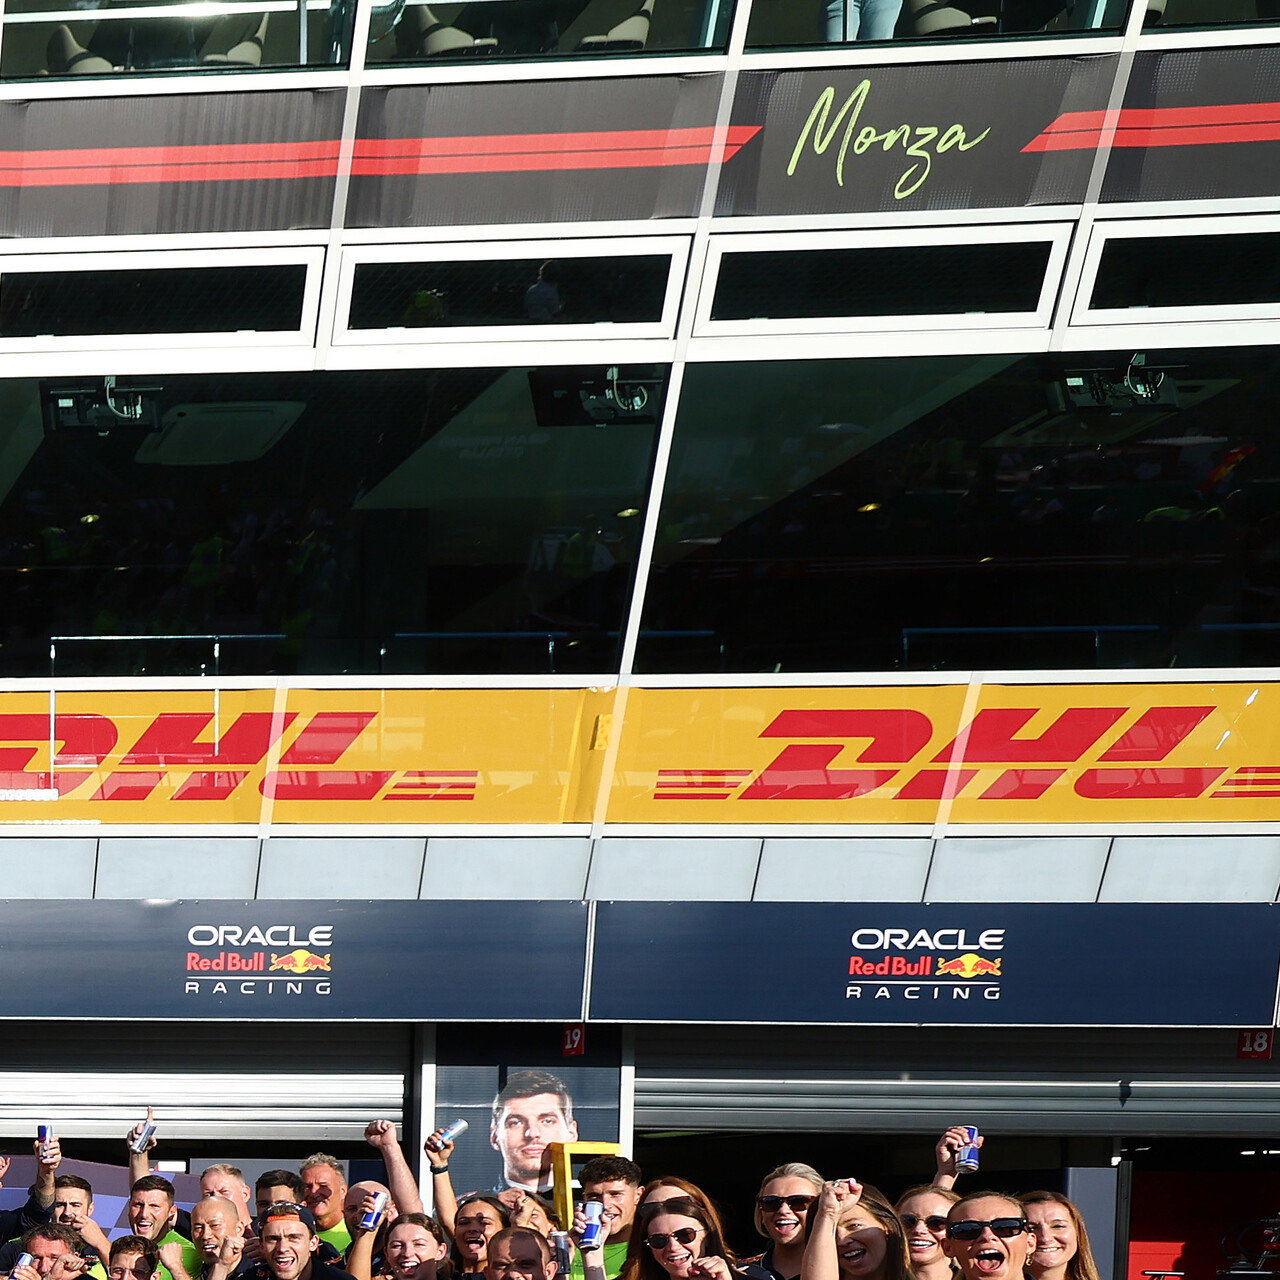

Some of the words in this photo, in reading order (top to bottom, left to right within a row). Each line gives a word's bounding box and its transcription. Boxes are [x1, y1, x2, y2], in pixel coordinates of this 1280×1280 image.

[786, 79, 990, 199] Monza
[737, 706, 1227, 800] DHL
[187, 925, 333, 947] ORACLE
[850, 928, 1005, 951] ORACLE
[185, 981, 332, 995] RACING
[845, 985, 1001, 1000] RACING
[565, 1029, 582, 1053] 19
[1241, 1031, 1269, 1052] 18
